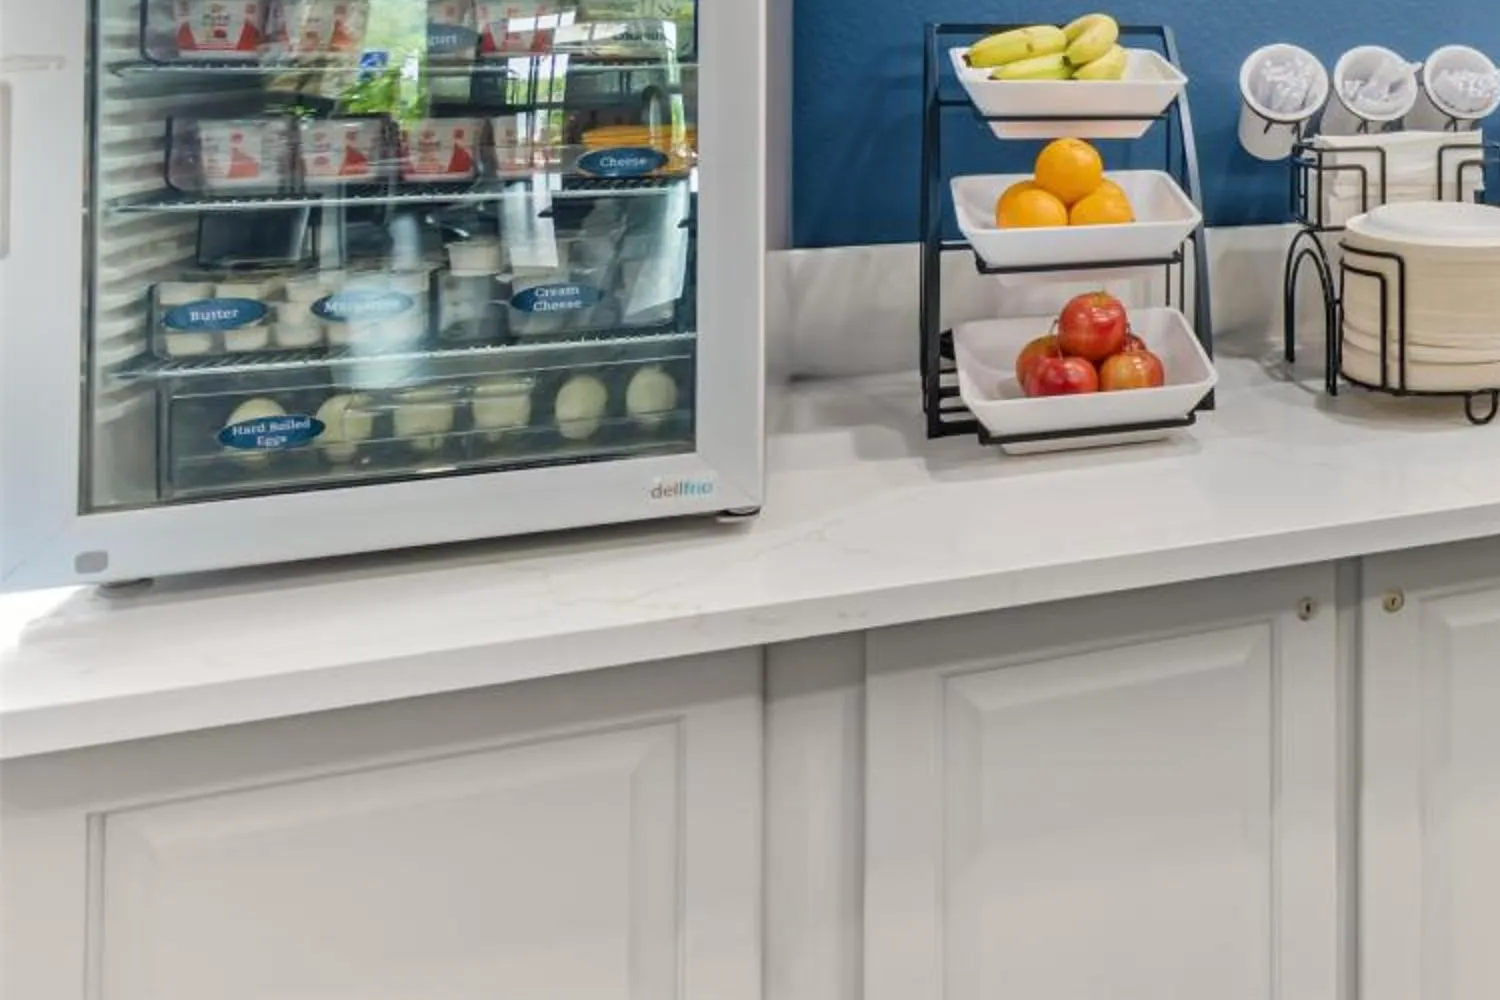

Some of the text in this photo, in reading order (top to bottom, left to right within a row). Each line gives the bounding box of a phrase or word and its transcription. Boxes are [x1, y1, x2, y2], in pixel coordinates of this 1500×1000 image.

[600, 156, 649, 169] Cheese
[534, 286, 580, 298] Cream
[532, 299, 582, 312] Cheese
[190, 308, 238, 321] Butter
[232, 418, 311, 436] Hard Boiled
[257, 434, 288, 448] Eggs
